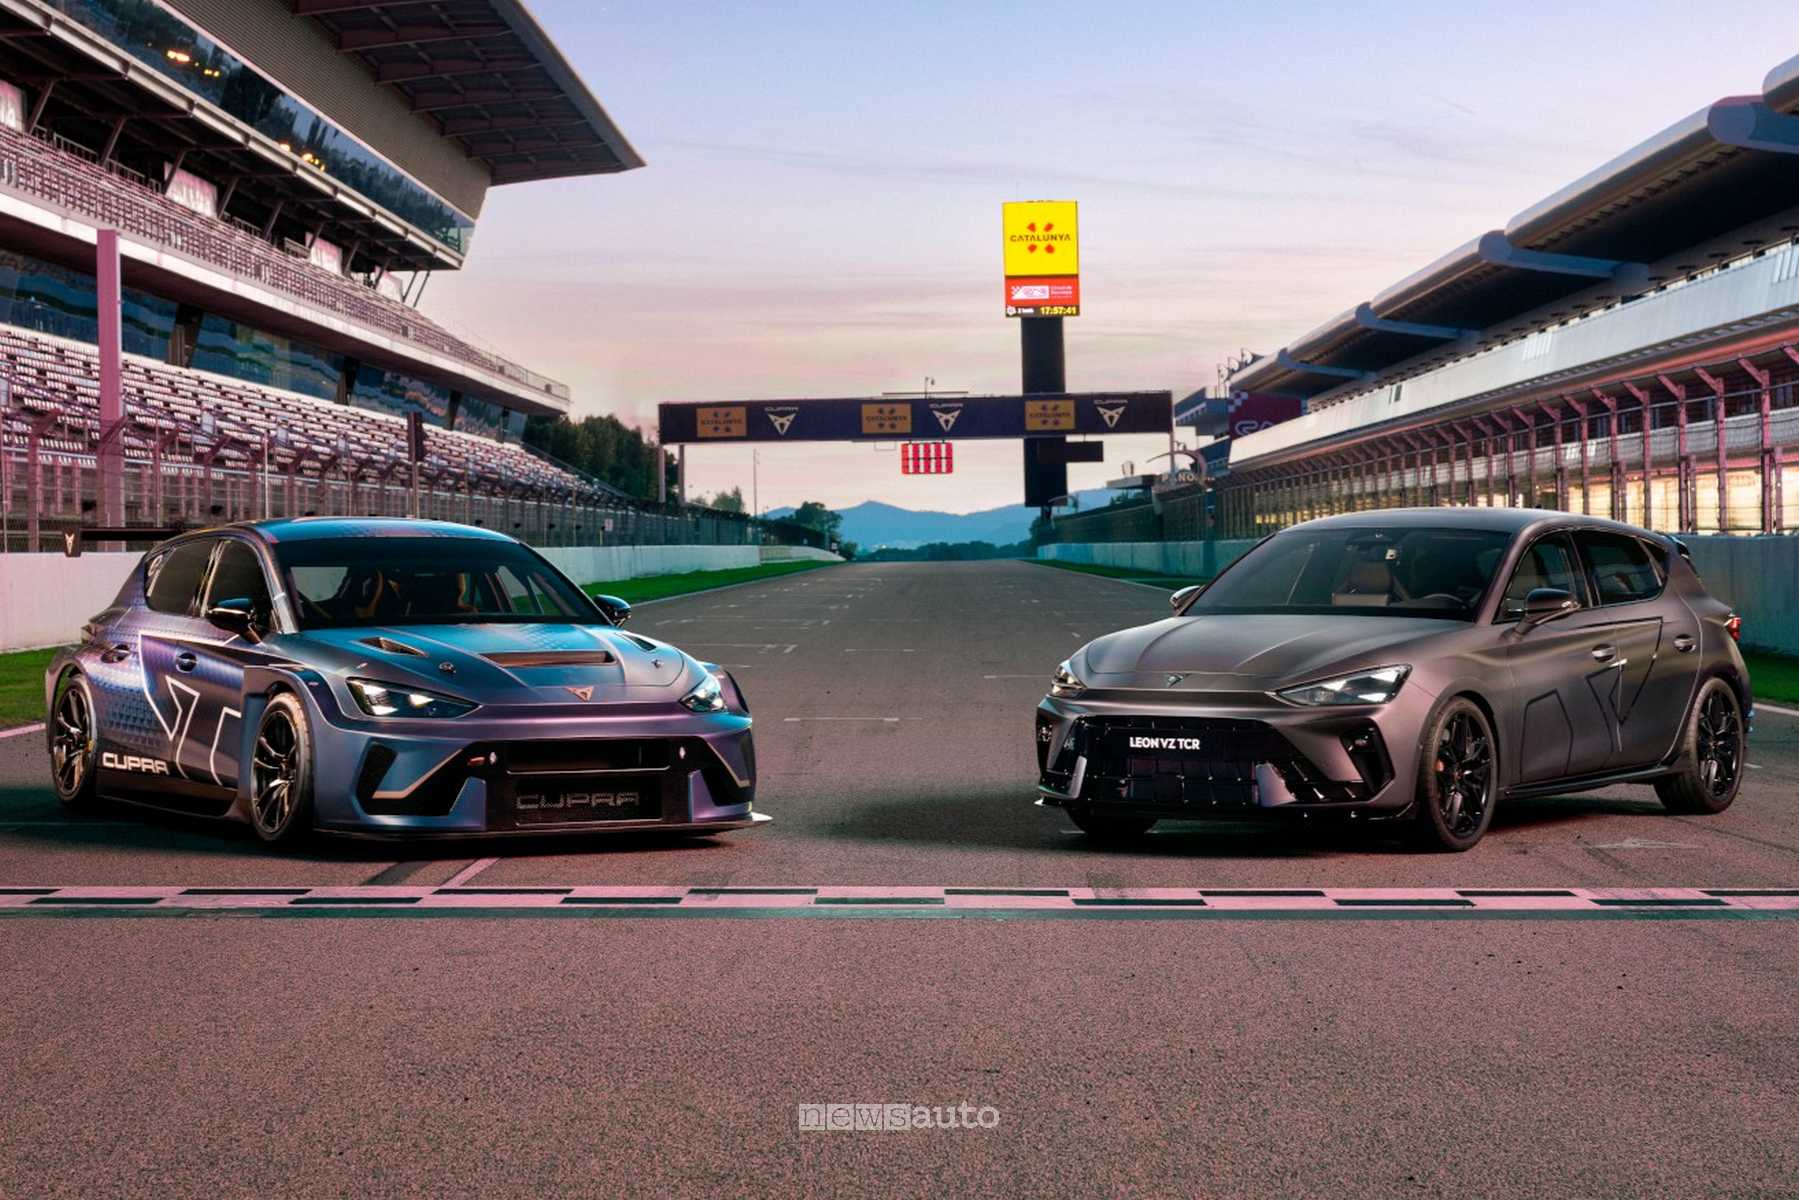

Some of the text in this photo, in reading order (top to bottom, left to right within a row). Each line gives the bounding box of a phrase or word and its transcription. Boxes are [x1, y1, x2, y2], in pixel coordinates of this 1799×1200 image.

[1010, 234, 1071, 242] CATALUNYA
[1040, 306, 1077, 315] 17:57:41
[1129, 736, 1201, 750] LEON VZ TCR
[102, 751, 170, 776] CUPRA
[516, 792, 640, 809] CUPRA
